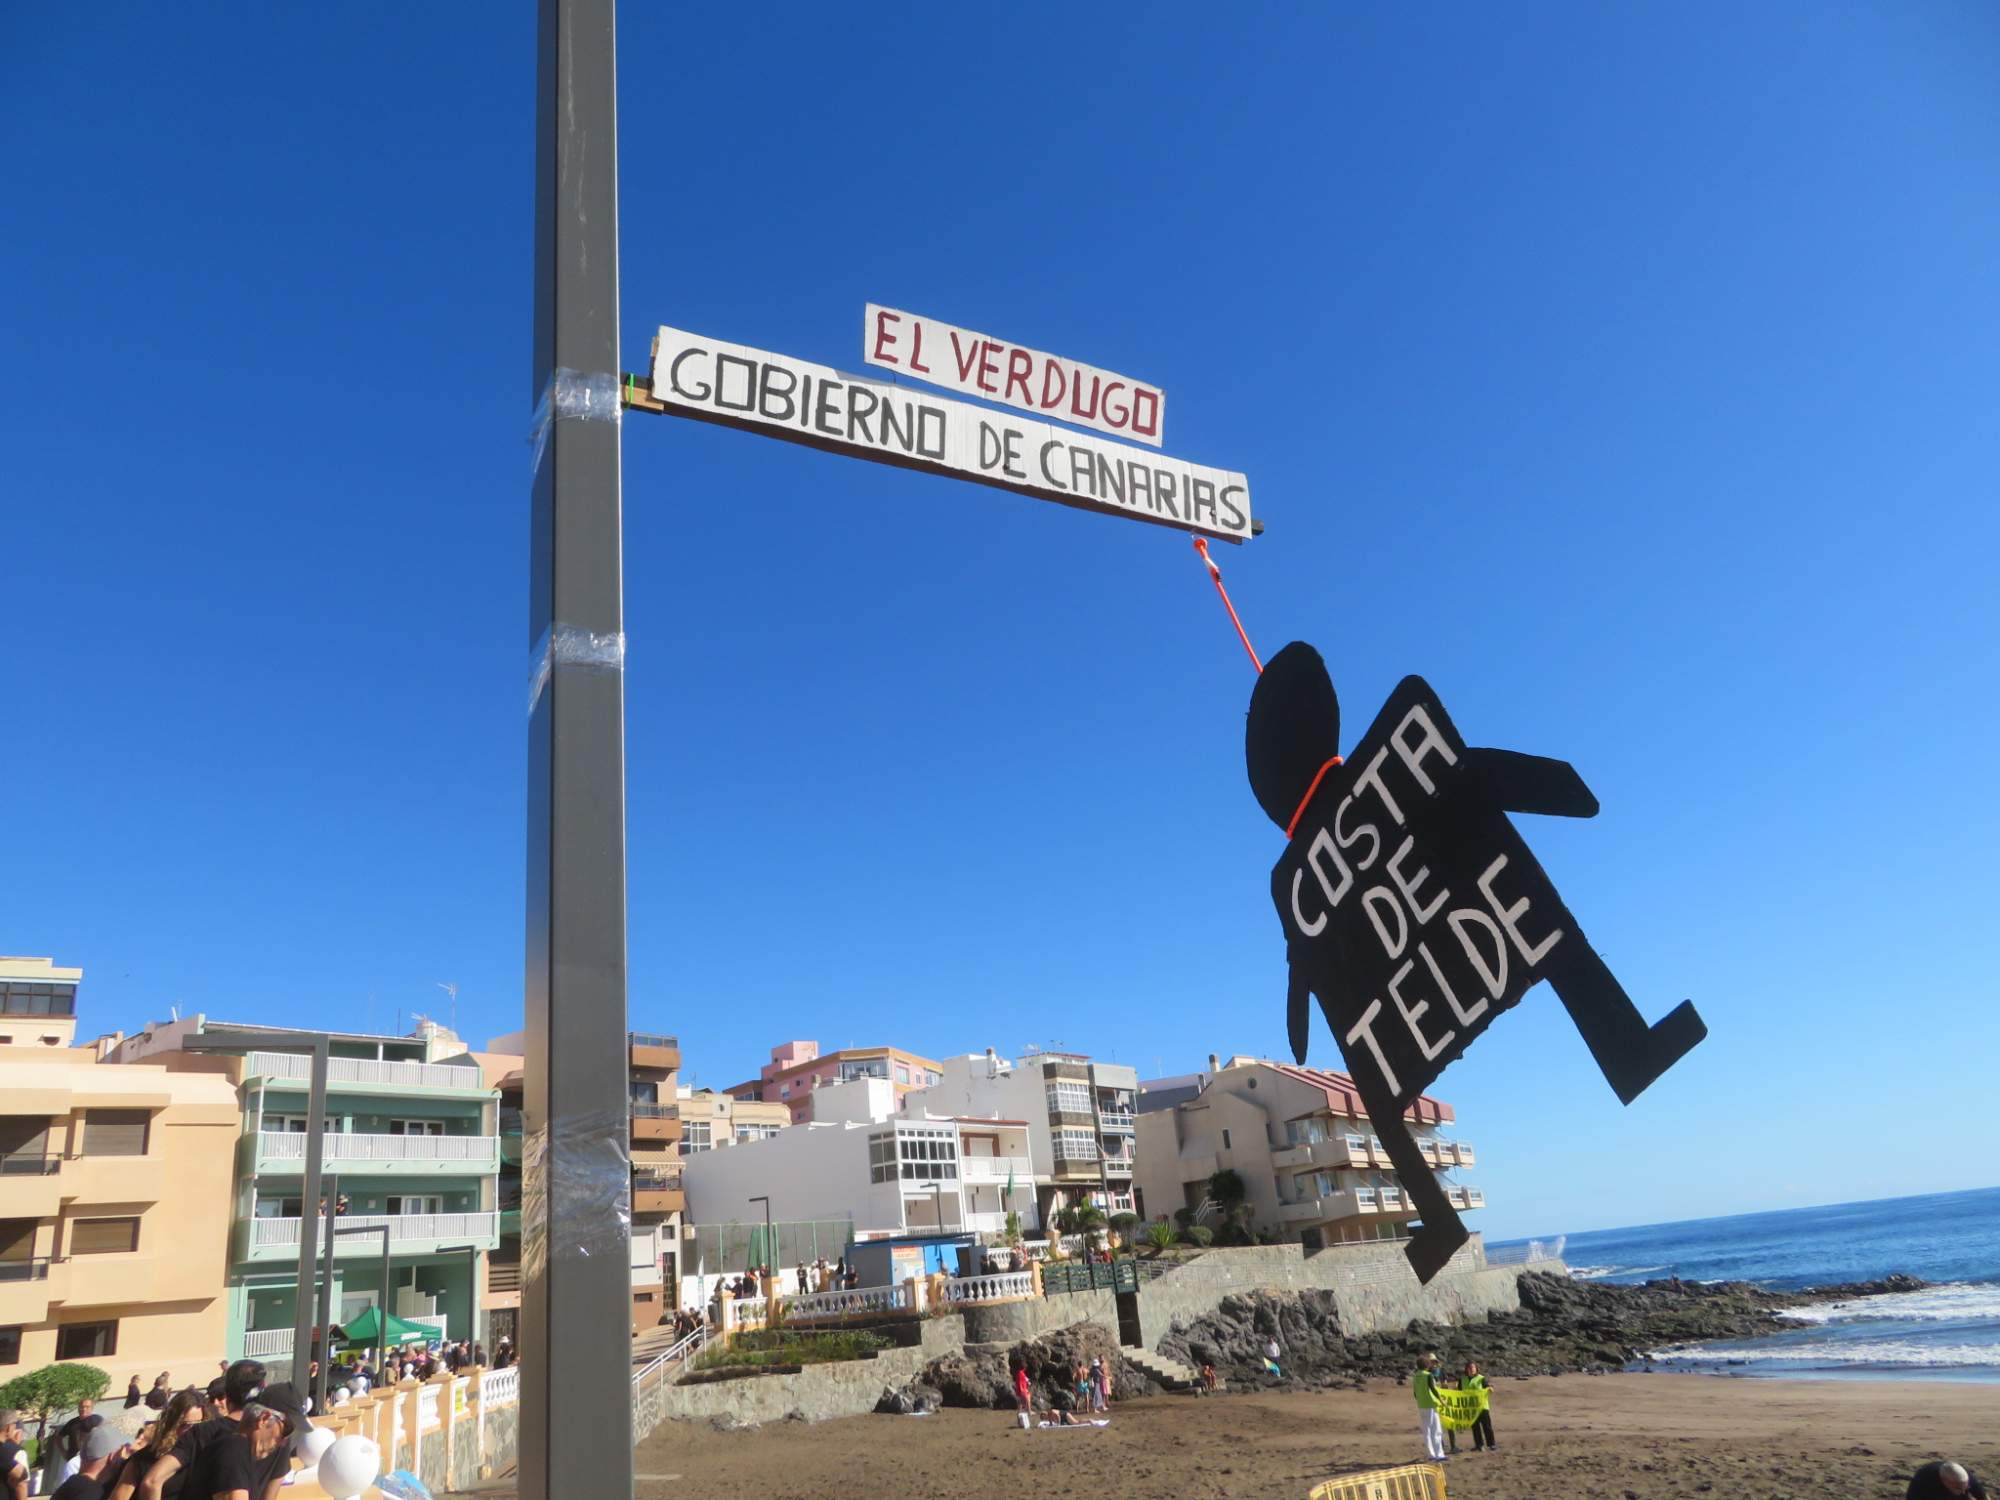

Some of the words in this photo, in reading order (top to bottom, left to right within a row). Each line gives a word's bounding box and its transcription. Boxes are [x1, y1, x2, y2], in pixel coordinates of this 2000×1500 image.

[670, 348, 946, 461] GOBIERNO
[980, 420, 1027, 479] DE
[1039, 440, 1247, 531] CANARIAS
[874, 311, 930, 374] EL
[950, 331, 1158, 437] VERDUGO
[1292, 704, 1458, 937] COSTA
[1362, 834, 1450, 960] DE
[1346, 853, 1563, 1097] TELDE
